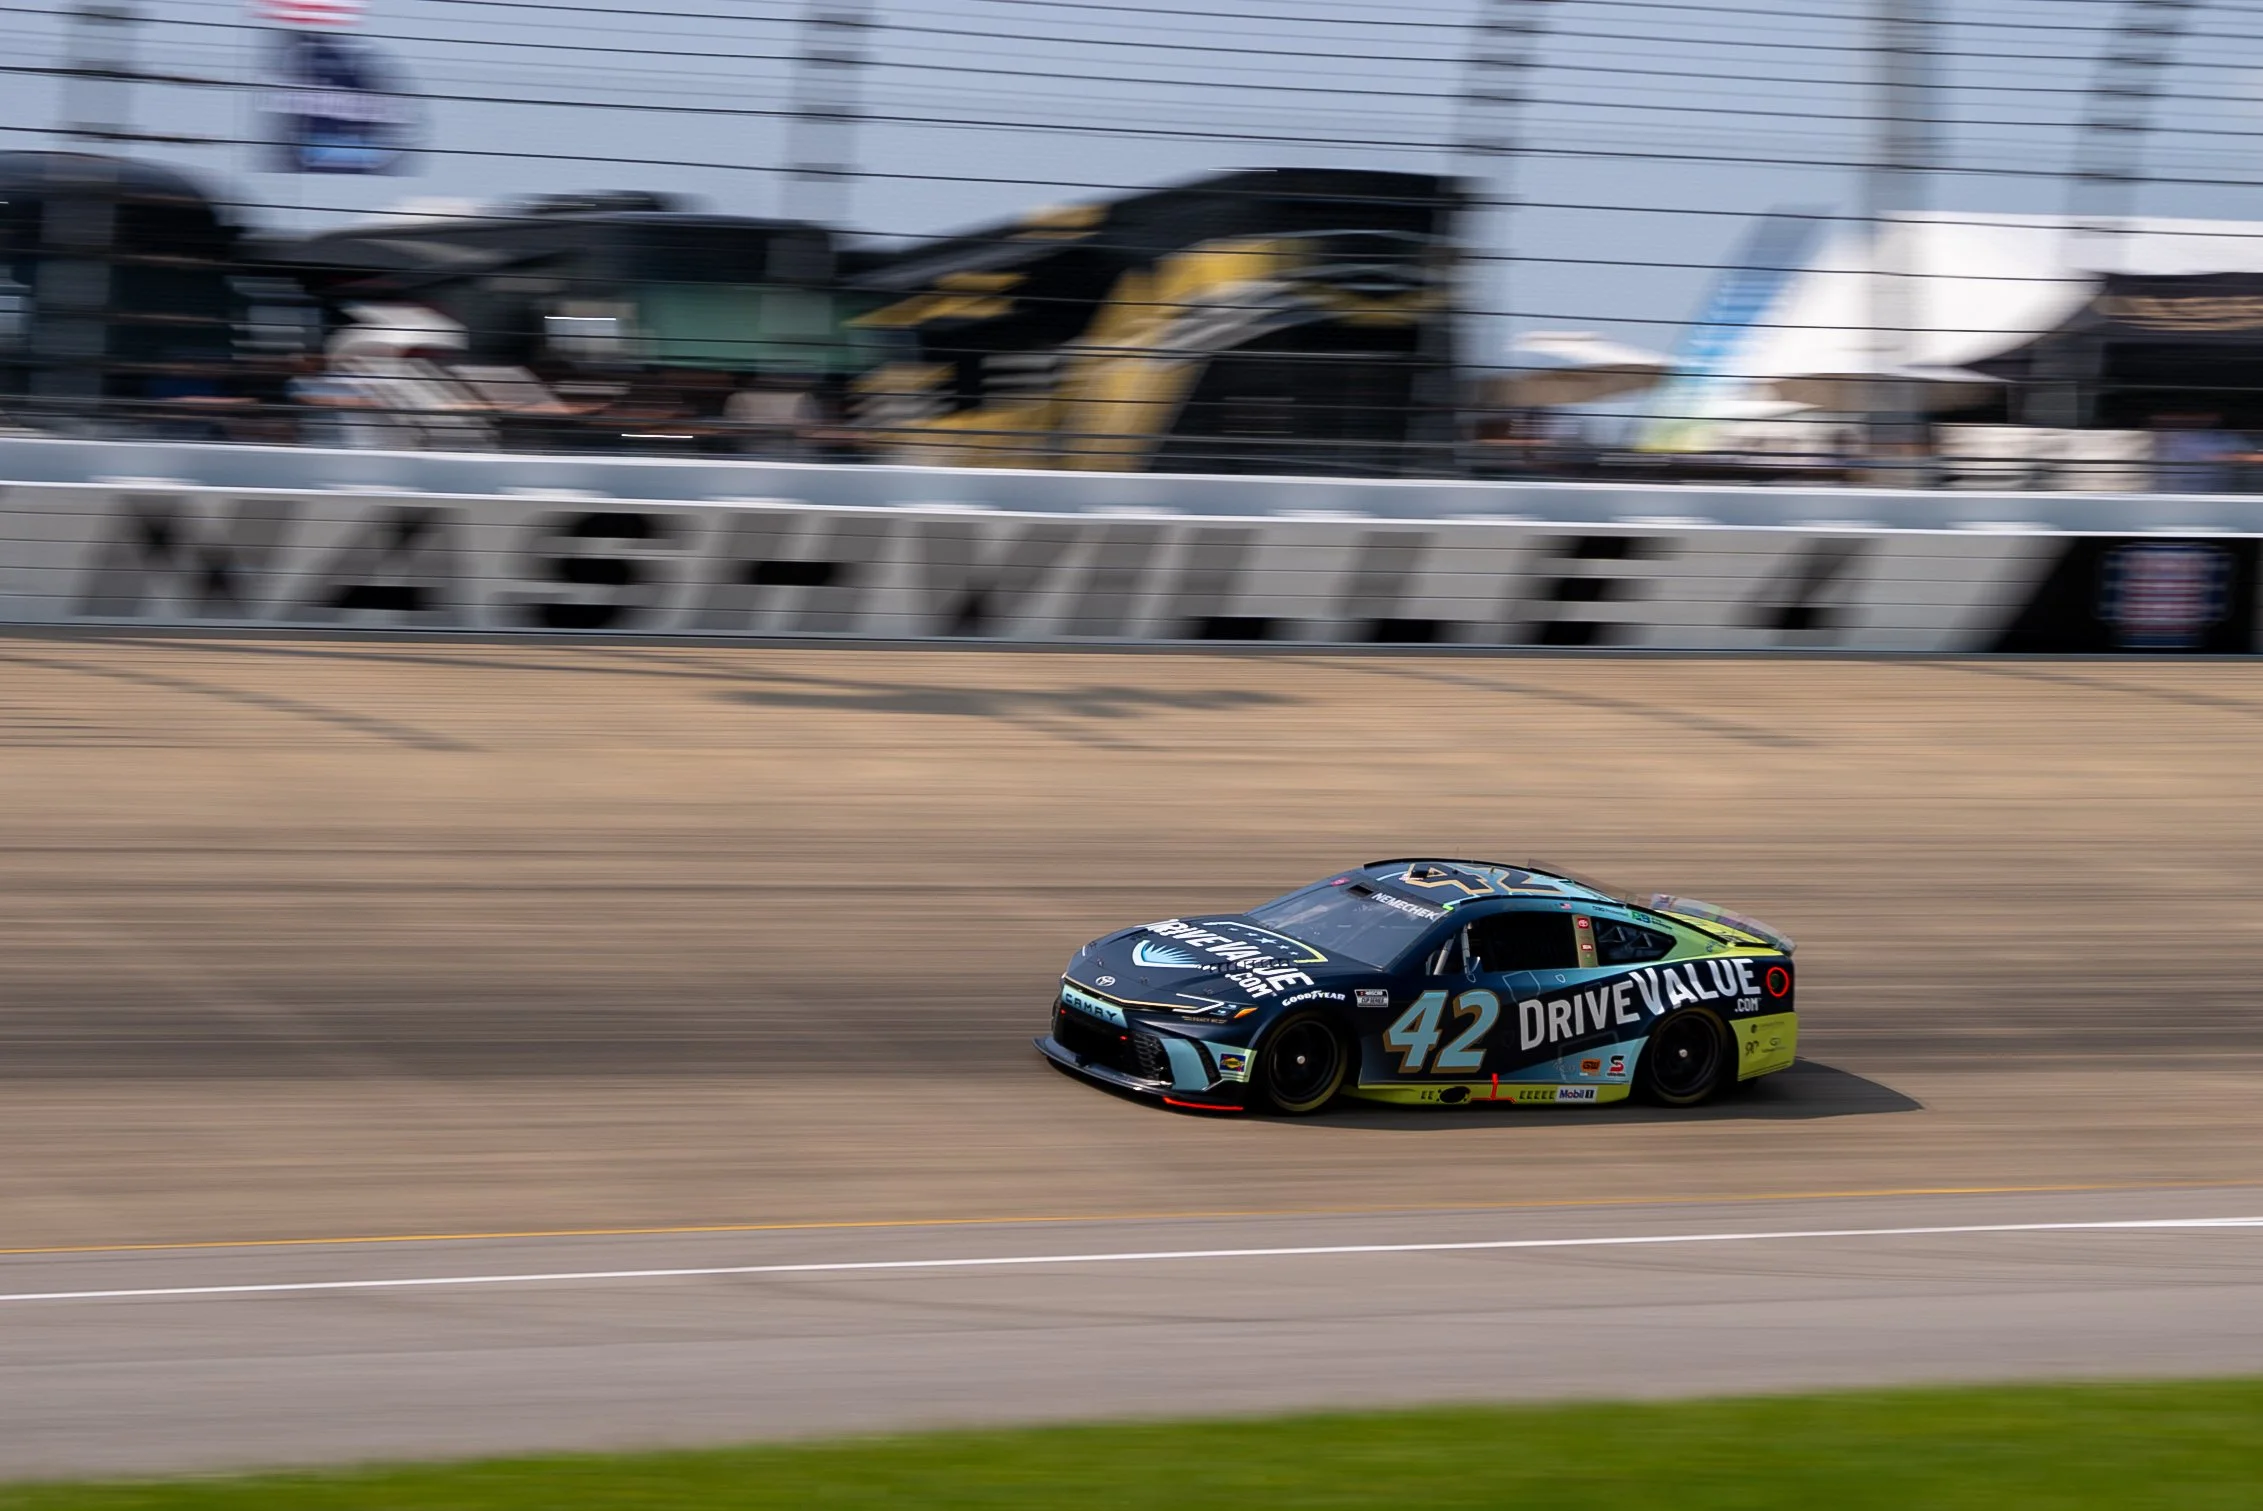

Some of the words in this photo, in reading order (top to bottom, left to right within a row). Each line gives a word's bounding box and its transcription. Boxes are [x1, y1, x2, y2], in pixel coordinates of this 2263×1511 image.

[75, 494, 1662, 647] NASHVILLE
[1371, 892, 1439, 920] NEMECHEK
[1225, 972, 1273, 998] .COM
[1282, 990, 1346, 1007] GOODYEAR
[1065, 993, 1117, 1021] CAMRY
[1519, 958, 1761, 1050] DRIVEVALUE
[1383, 989, 1500, 1074] 42
[1559, 1090, 1584, 1099] Mobil
